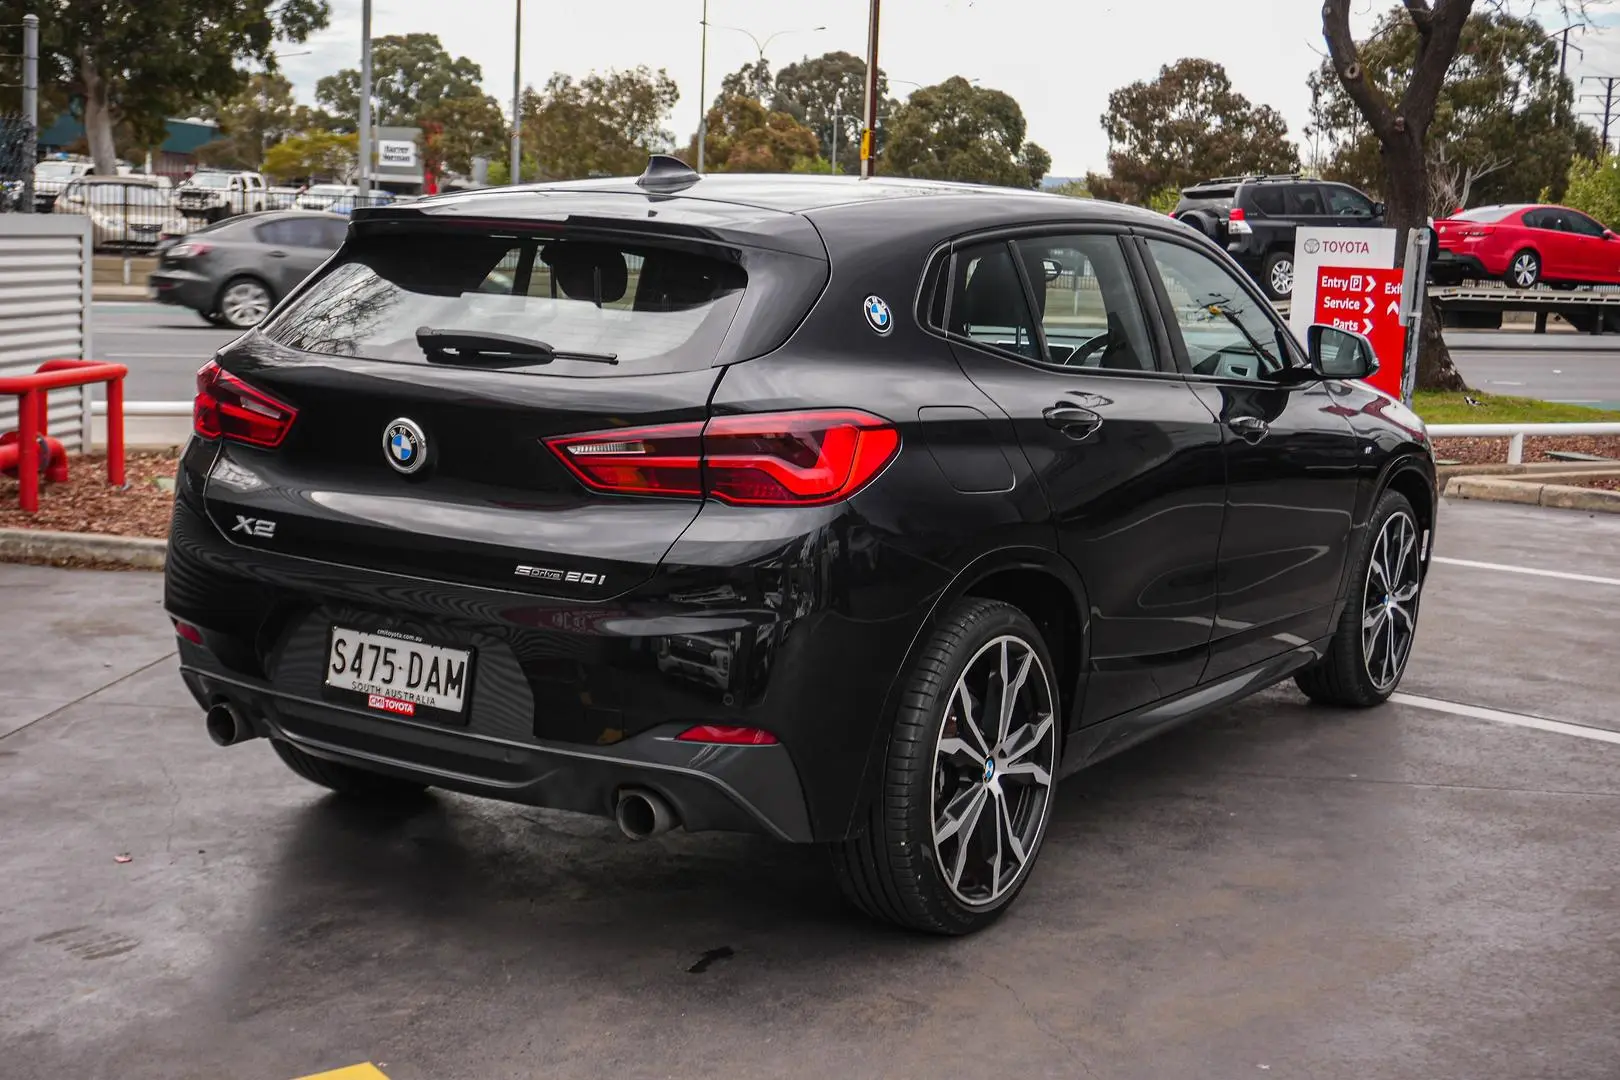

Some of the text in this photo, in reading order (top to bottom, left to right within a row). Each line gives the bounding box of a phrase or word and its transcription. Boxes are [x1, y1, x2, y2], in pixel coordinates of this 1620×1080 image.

[1323, 241, 1369, 254] TOYOTA
[1321, 276, 1349, 291] Entry
[1323, 296, 1361, 310] Service
[1333, 318, 1359, 332] Parts
[231, 515, 276, 538] X2
[376, 629, 422, 642] cmitoyota.com.au
[351, 681, 436, 706] SOUTH AUSTRALIA
[385, 699, 413, 713] TOYOTA
